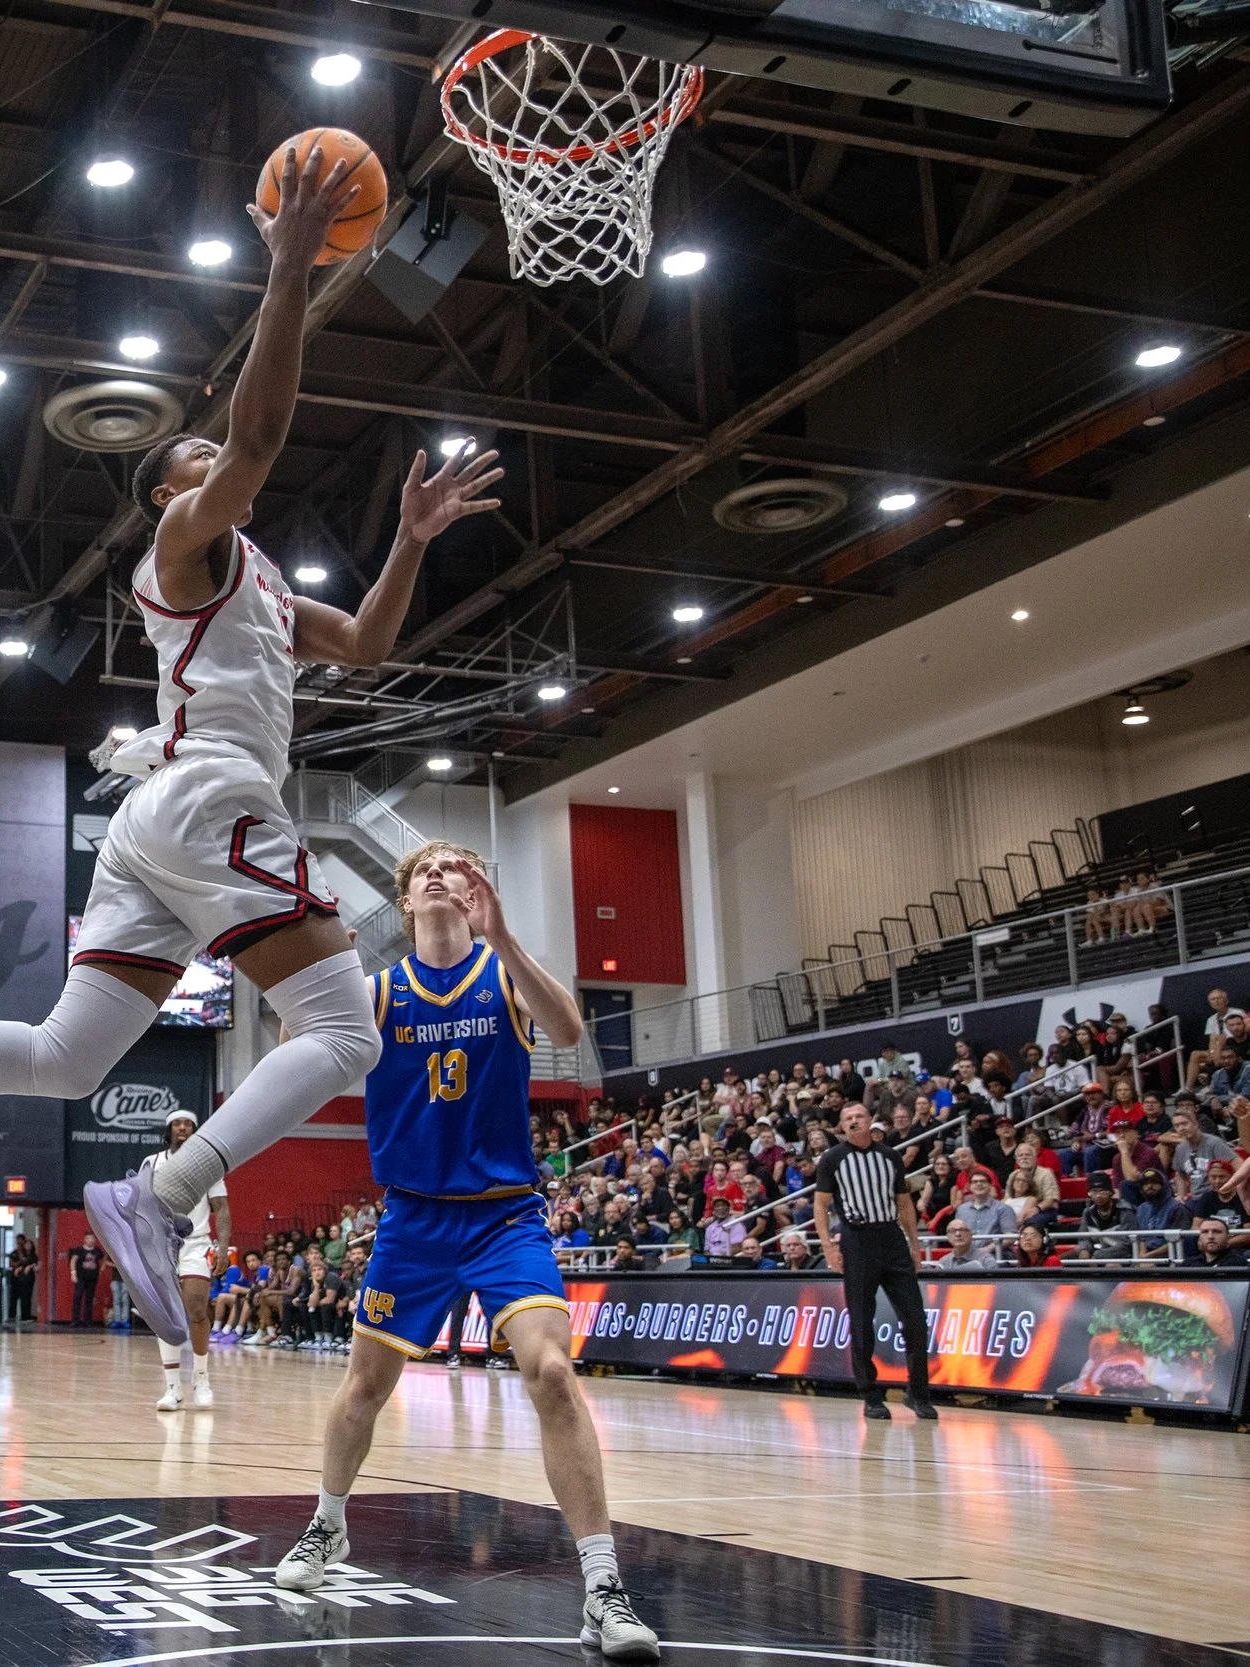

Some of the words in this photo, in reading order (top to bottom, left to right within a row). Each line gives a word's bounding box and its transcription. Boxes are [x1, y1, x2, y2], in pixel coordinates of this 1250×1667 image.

[395, 1025, 414, 1043] UC
[416, 1016, 498, 1043] RIVERSIDE
[426, 1048, 468, 1103] 13
[96, 1082, 173, 1123] Cane's
[71, 1131, 96, 1142] PROUD
[97, 1132, 129, 1143] SPONSOR
[130, 1133, 140, 1143] OF
[141, 1133, 161, 1144] CSUN
[633, 1303, 747, 1344] BURGERS
[7, 1566, 241, 1633] WEST
